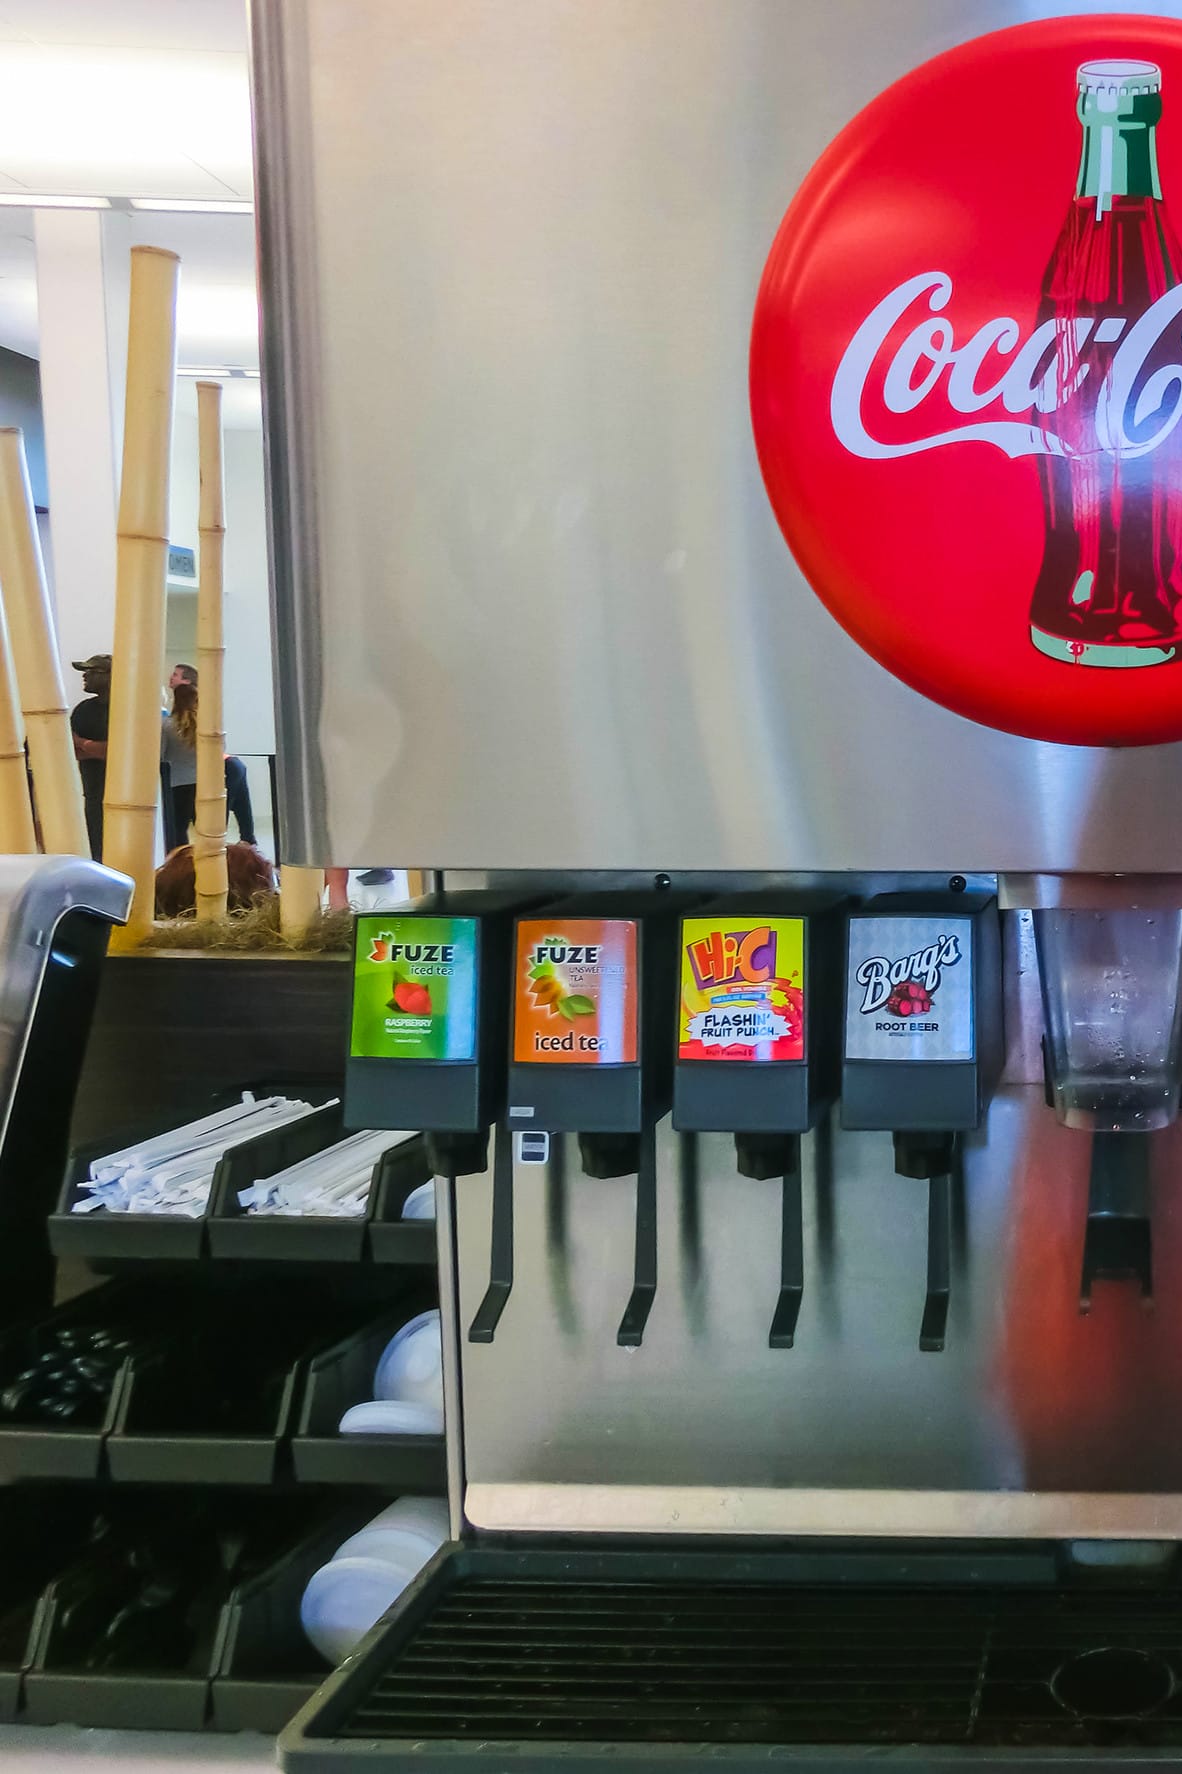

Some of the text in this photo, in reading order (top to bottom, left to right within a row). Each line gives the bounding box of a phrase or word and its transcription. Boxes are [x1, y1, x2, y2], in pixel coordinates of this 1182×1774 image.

[168, 552, 195, 573] OMEN
[391, 945, 455, 962] FUZE
[536, 946, 598, 964] FUZE
[691, 926, 771, 983] Hi-C
[411, 965, 454, 975] iced tea
[856, 934, 963, 1015] Barq's
[385, 1018, 432, 1027] RASPBERRY
[875, 1022, 939, 1031] ROOT BEER
[535, 1032, 608, 1051] iced tea
[701, 1028, 732, 1038] FRUIT
